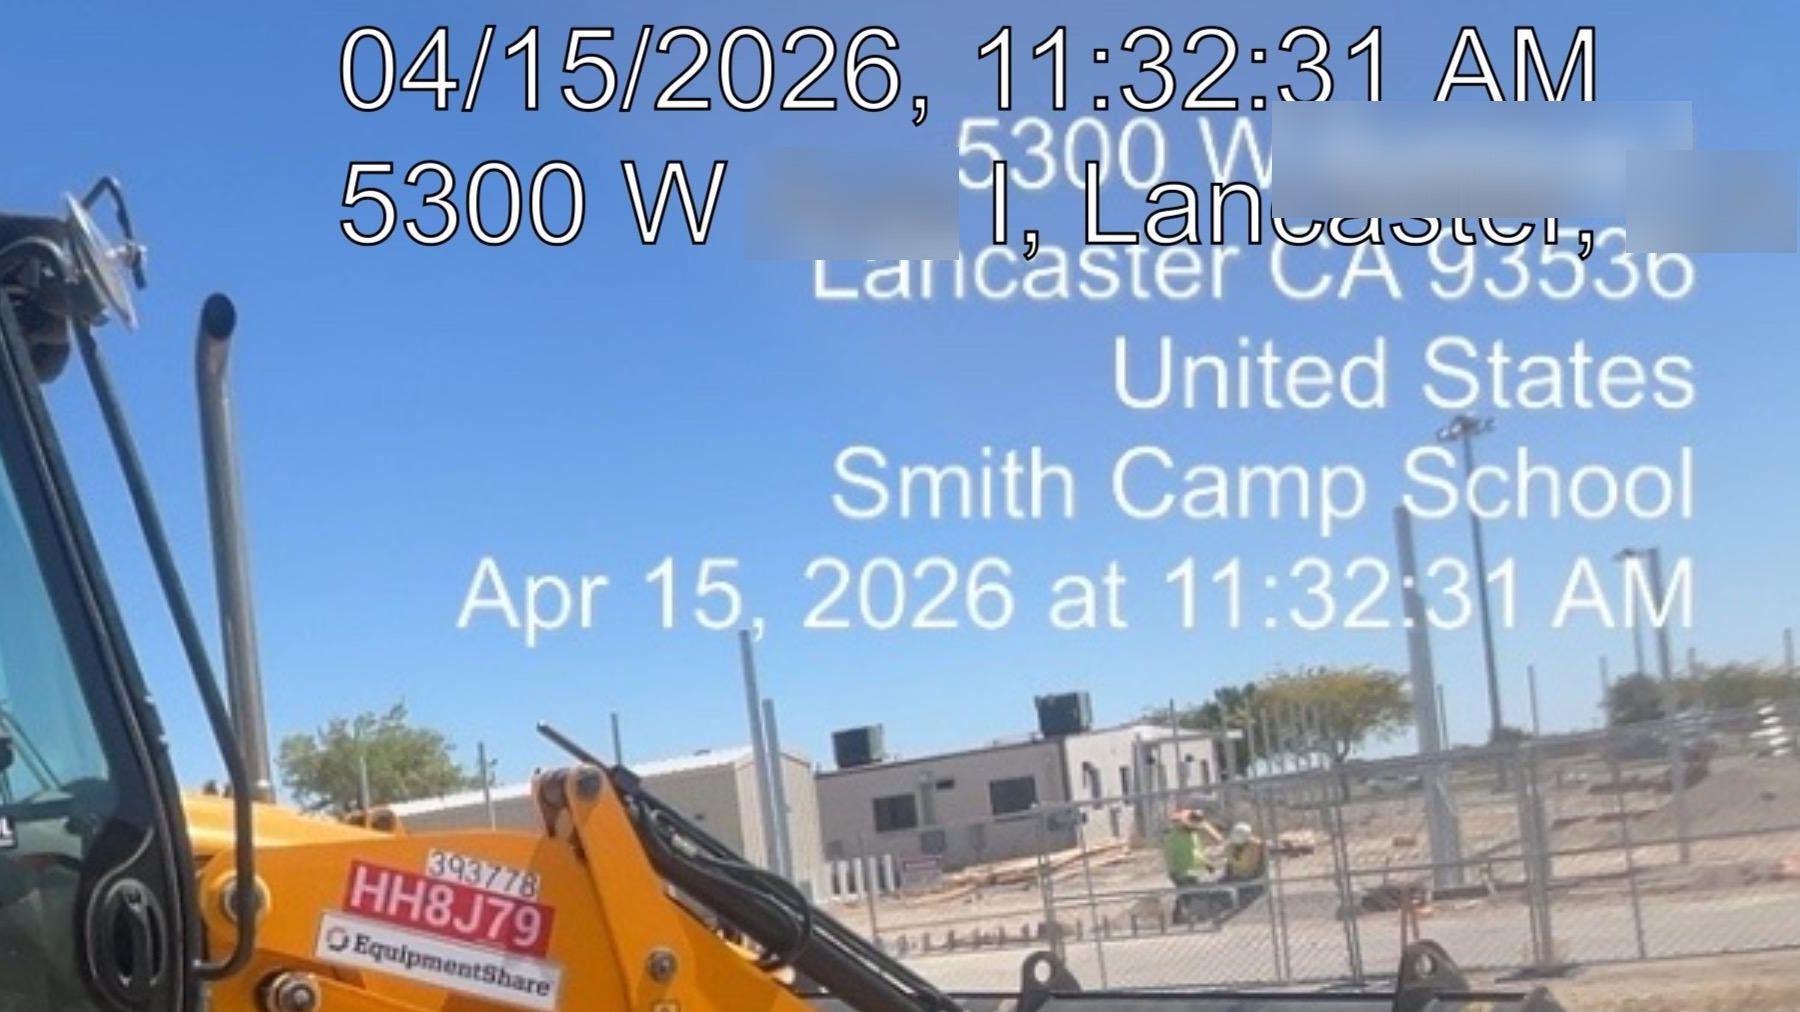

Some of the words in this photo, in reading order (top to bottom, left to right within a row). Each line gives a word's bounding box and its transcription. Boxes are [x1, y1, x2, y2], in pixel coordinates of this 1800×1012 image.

[350, 865, 542, 948] HH8J79
[429, 850, 538, 898] 393778
[353, 932, 552, 998] EquipmentShare
